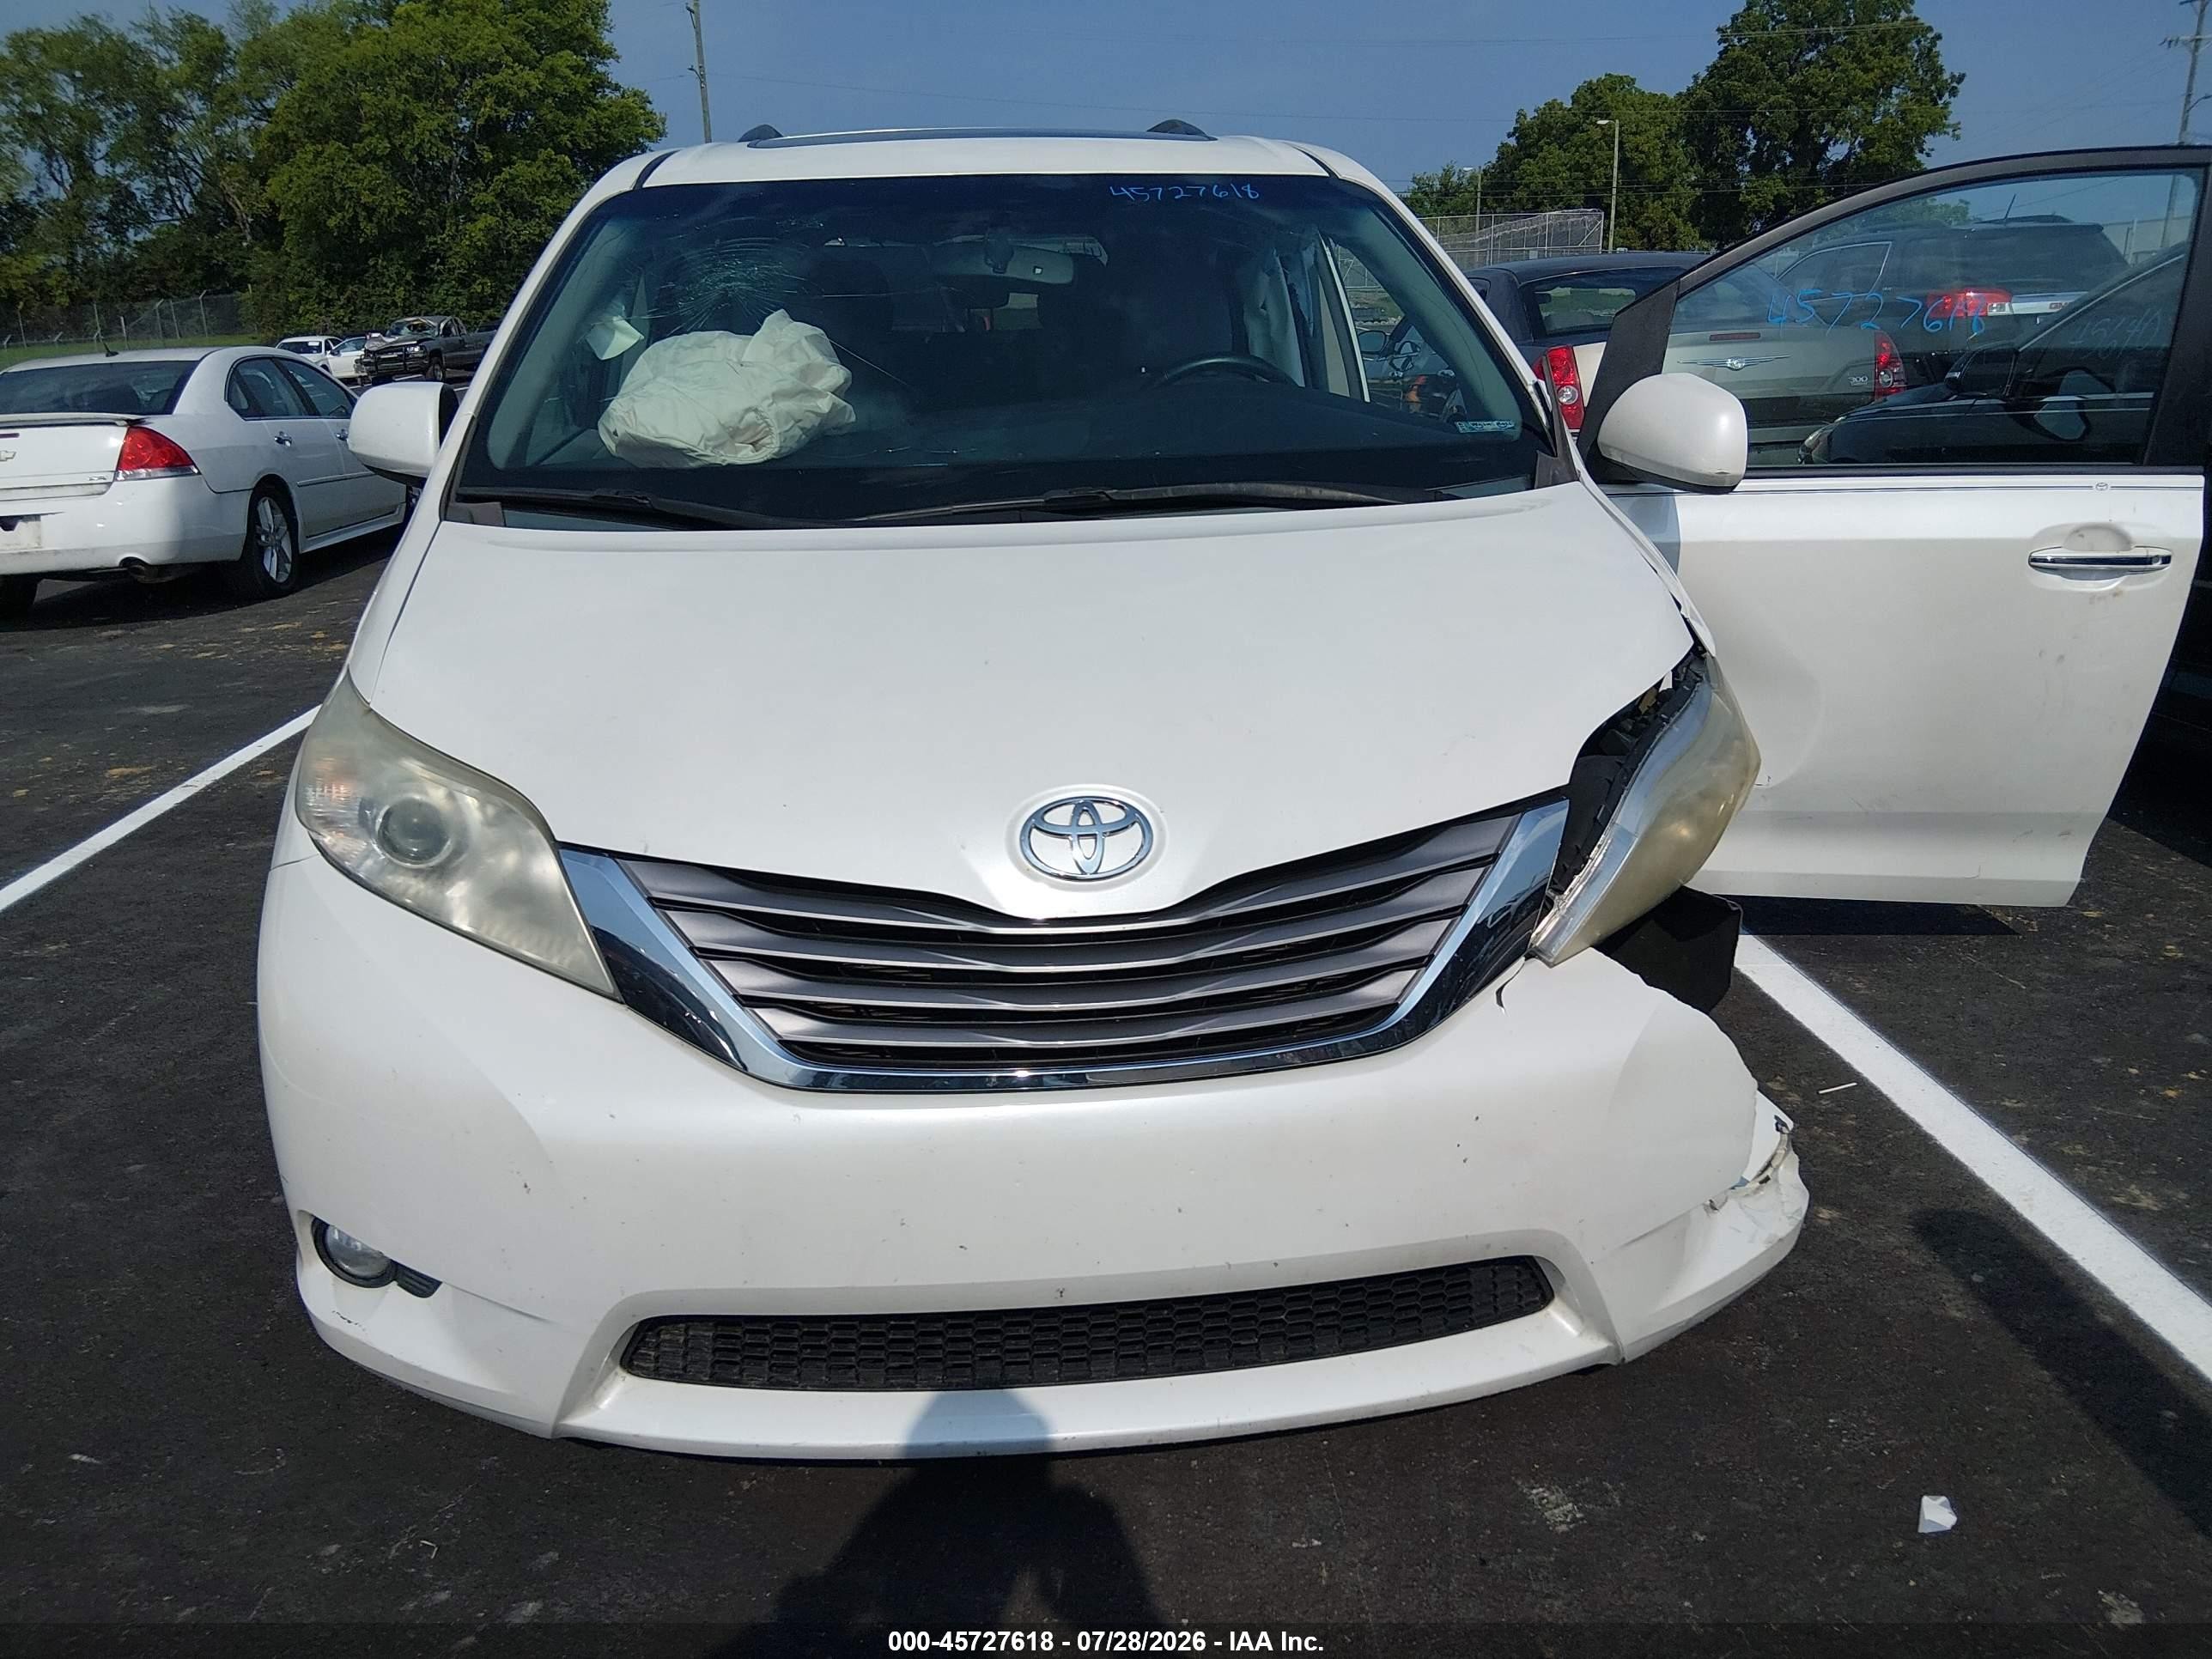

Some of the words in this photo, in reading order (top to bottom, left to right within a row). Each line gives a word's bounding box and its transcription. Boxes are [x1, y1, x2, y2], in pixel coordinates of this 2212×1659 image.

[1109, 182, 1260, 203] 45727618
[1766, 289, 1985, 337] 45727618
[1848, 375, 1869, 384] 300
